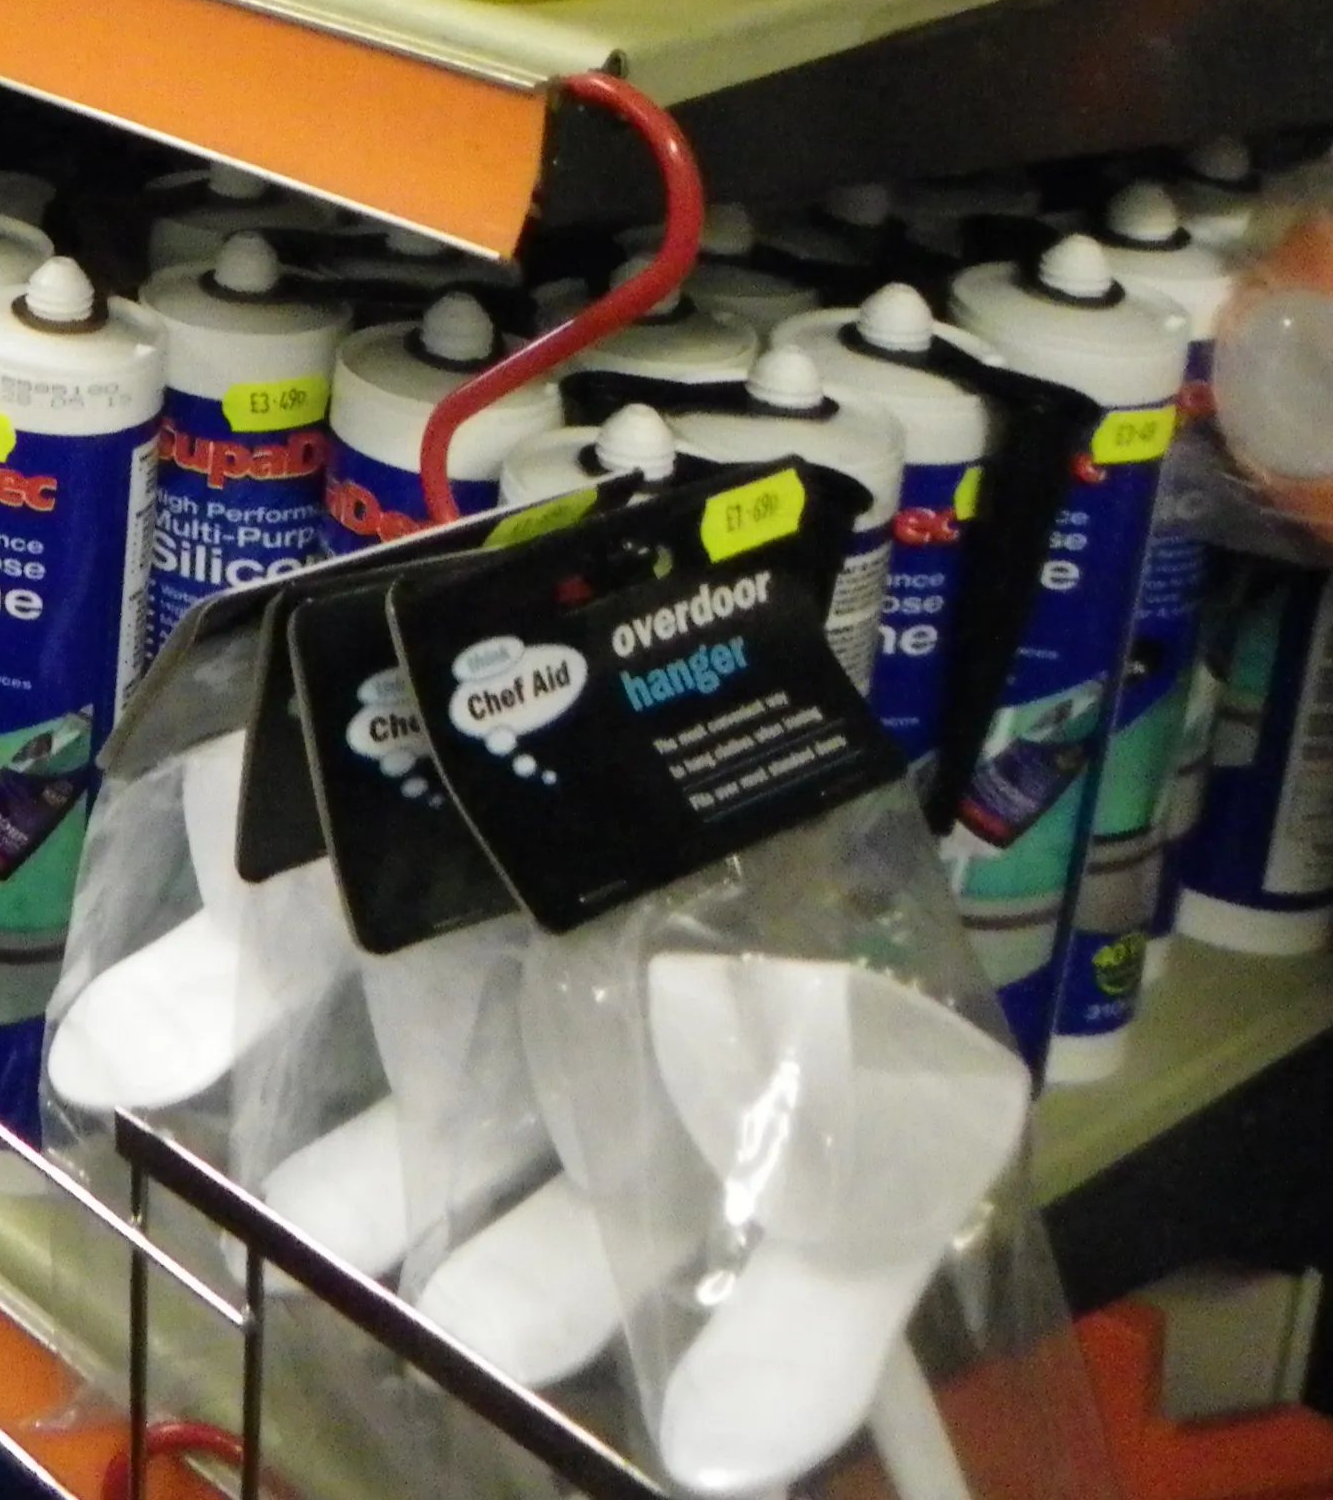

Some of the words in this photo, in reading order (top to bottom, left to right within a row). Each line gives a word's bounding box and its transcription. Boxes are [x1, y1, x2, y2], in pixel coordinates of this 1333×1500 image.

[611, 569, 773, 659] overdoor
[466, 681, 526, 722] Chef
[530, 659, 571, 699] Aid
[619, 634, 748, 712] hanger
